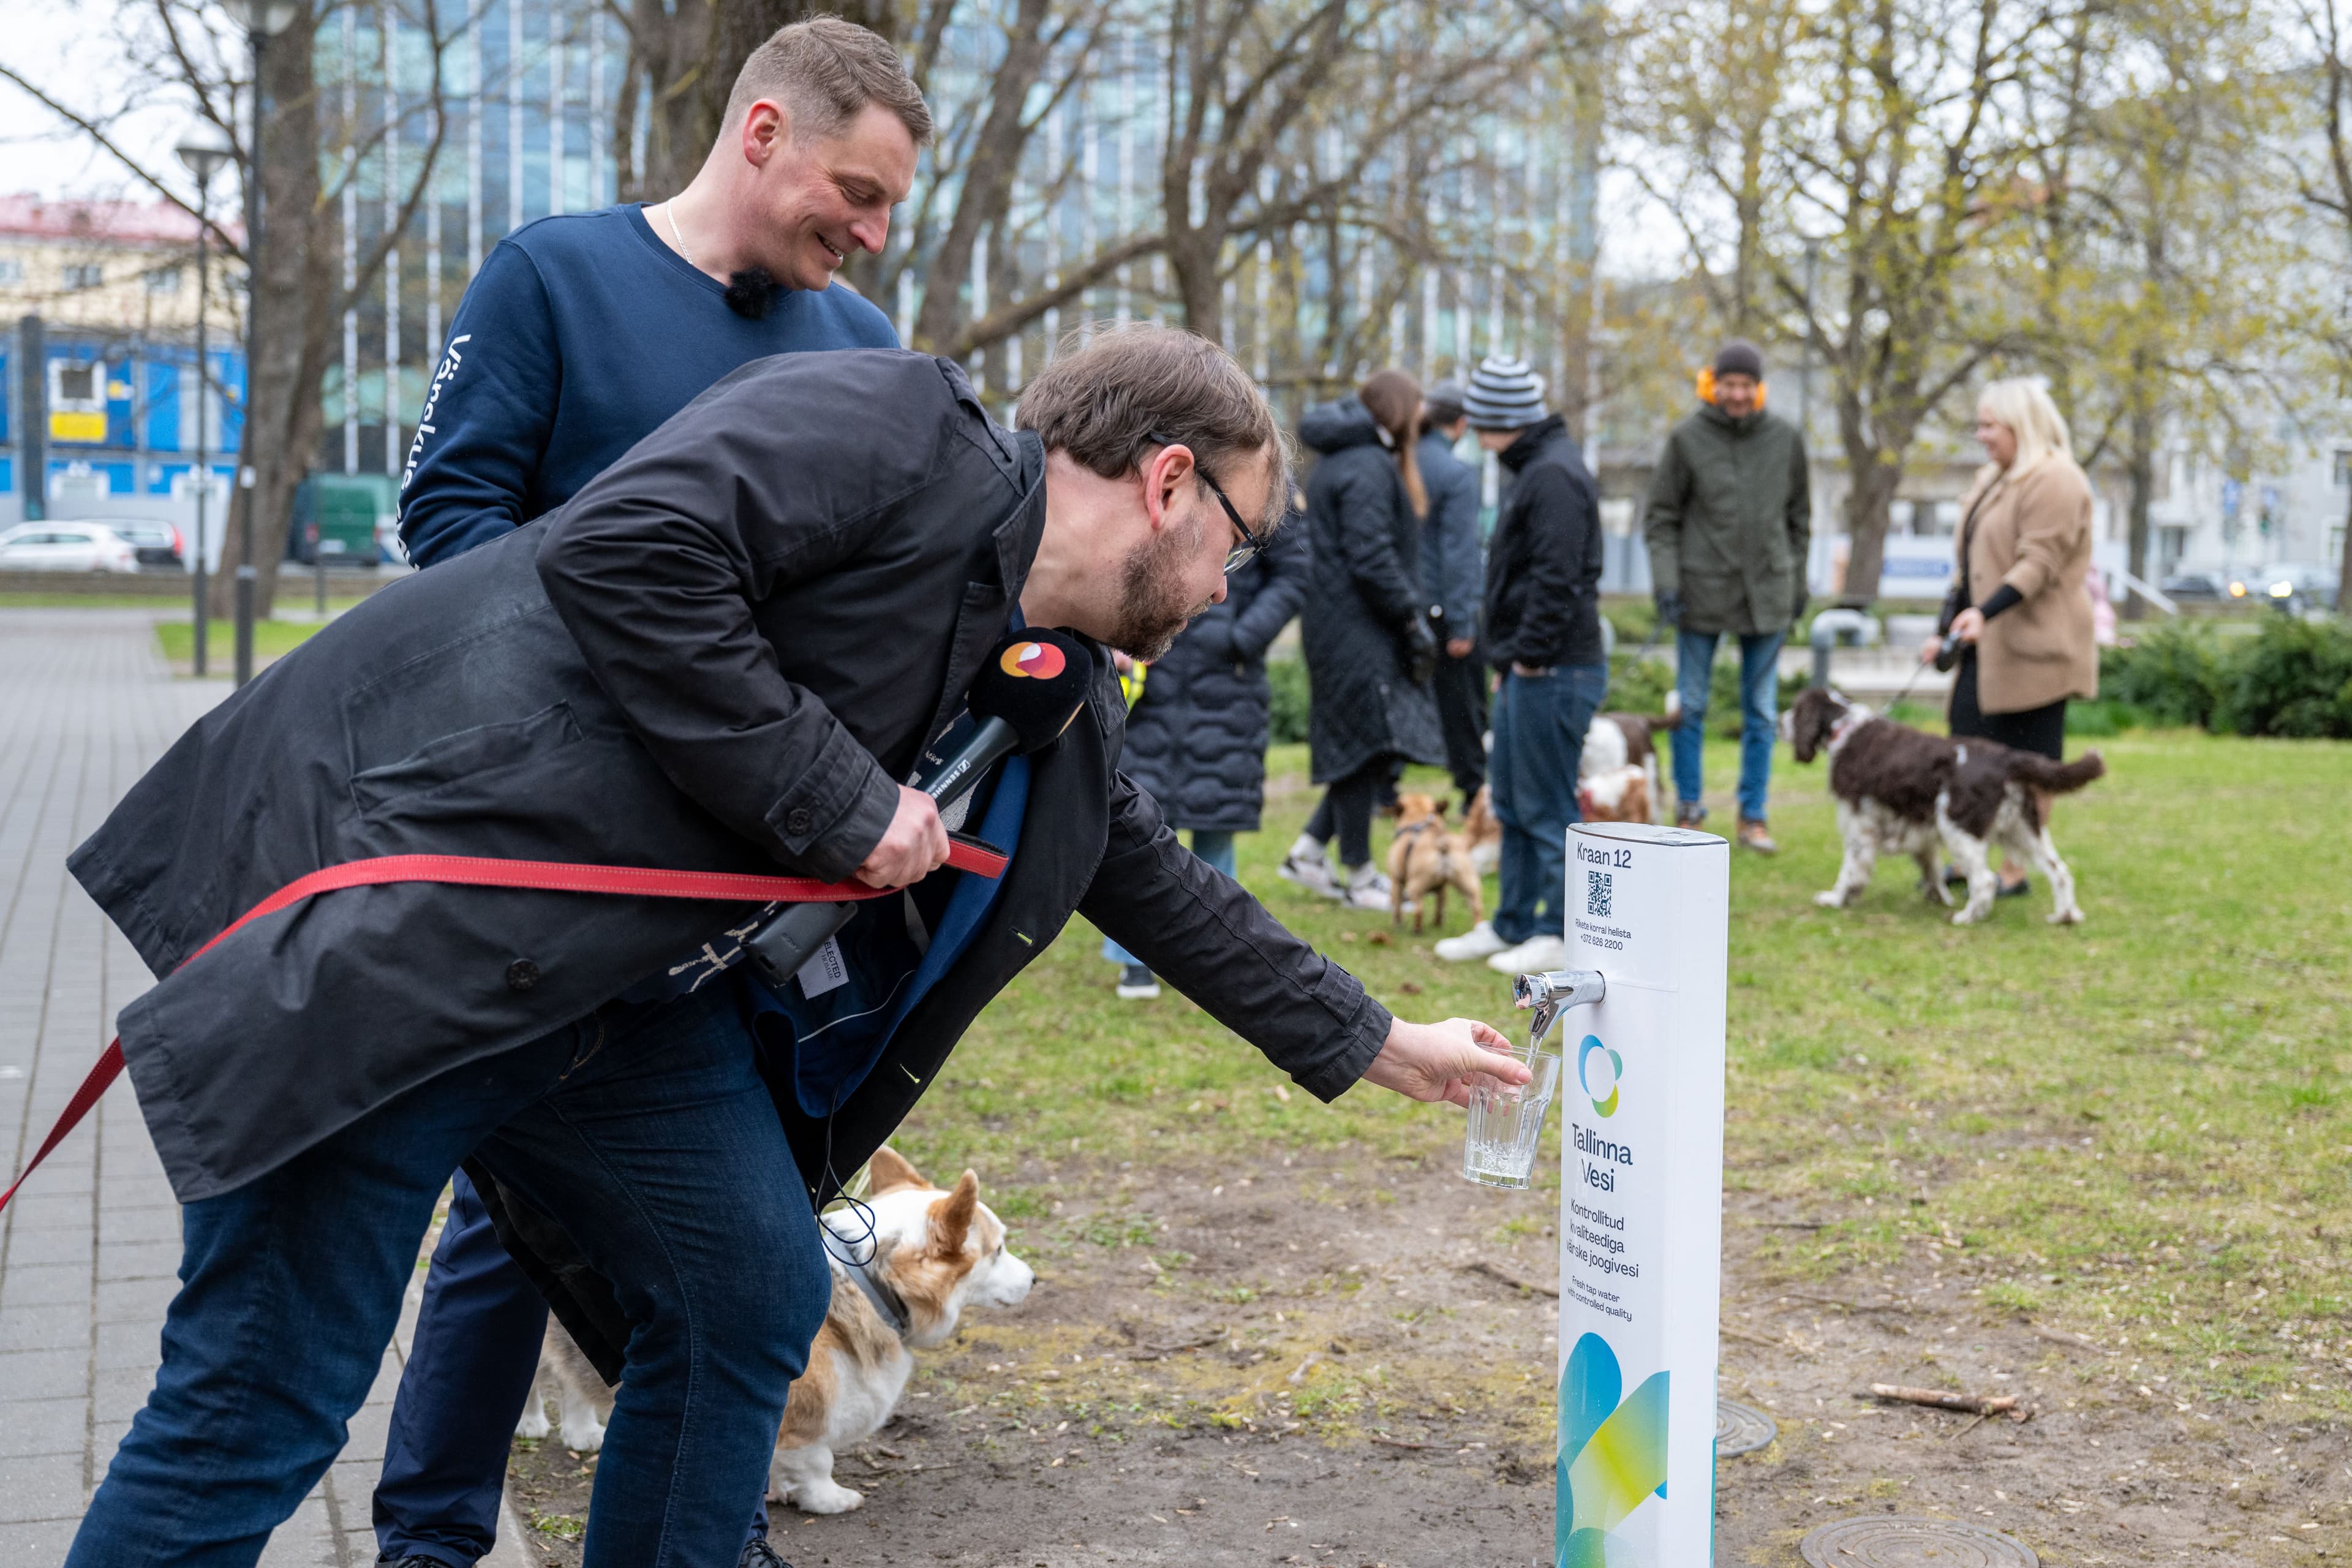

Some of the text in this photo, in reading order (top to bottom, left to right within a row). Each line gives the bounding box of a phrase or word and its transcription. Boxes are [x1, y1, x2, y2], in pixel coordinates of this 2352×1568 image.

[930, 770, 960, 799] SENNHE
[1577, 842, 1632, 869] Kraan 12
[1575, 918, 1632, 939] Rikete korral helista
[1580, 933, 1623, 951] +372 626 2200
[821, 954, 834, 981] HOMME
[824, 941, 840, 978] ELECTED
[1572, 1123, 1633, 1165] Tallinna
[1581, 1158, 1615, 1192] Vesi
[1570, 1198, 1624, 1231] Kontrollitud
[1569, 1218, 1625, 1253] kvaliteediga
[1566, 1238, 1639, 1278] värske joogivesi
[1572, 1275, 1620, 1303] Fresh tap water
[1575, 1291, 1604, 1311] controlled
[1605, 1304, 1632, 1322] quality
